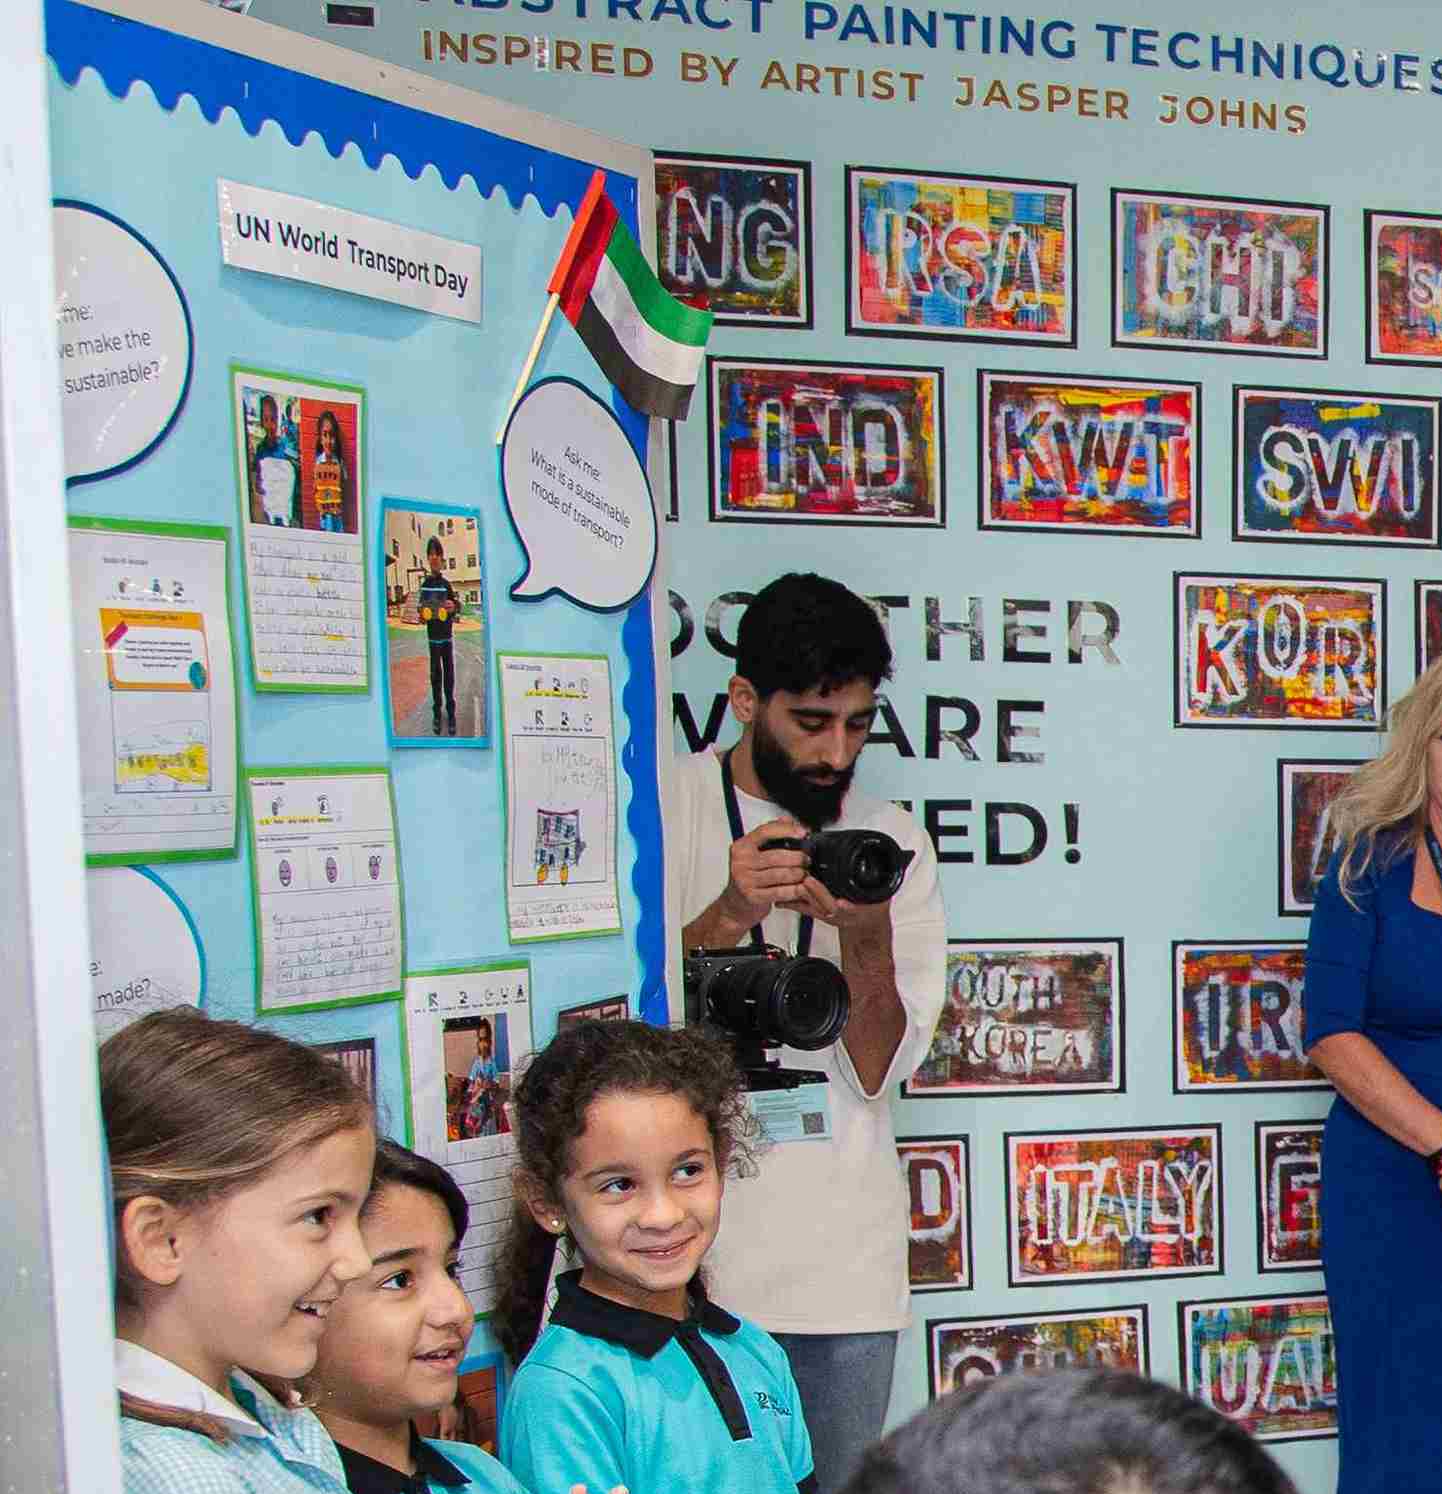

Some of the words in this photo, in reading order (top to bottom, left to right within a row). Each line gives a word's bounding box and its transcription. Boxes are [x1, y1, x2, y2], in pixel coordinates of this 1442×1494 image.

[804, 1, 1077, 58] PAINTING
[422, 30, 655, 78] INSPIRED
[680, 52, 739, 86] BY
[760, 60, 925, 102] ARTIST
[955, 76, 1129, 120] JASPER
[1159, 95, 1308, 135] JOHNS
[236, 212, 271, 242] UN
[277, 220, 339, 259] World
[347, 239, 430, 284] Transport
[434, 264, 468, 298] Day
[877, 206, 1042, 311] RSA
[65, 360, 160, 394] sustainable?
[78, 333, 121, 356] make
[124, 329, 152, 350] the
[530, 447, 557, 480] What
[575, 484, 631, 529] sustainable
[564, 446, 582, 469] Ask
[758, 398, 907, 495] IND
[1000, 403, 1188, 500] KWT
[1256, 423, 1423, 517] SWI
[531, 480, 560, 511] mode
[573, 508, 624, 550] transport?
[1192, 593, 1371, 704] KOR
[97, 978, 152, 1008] made?
[958, 1022, 1091, 1070] KOREA
[1023, 1157, 1214, 1246] ITALY
